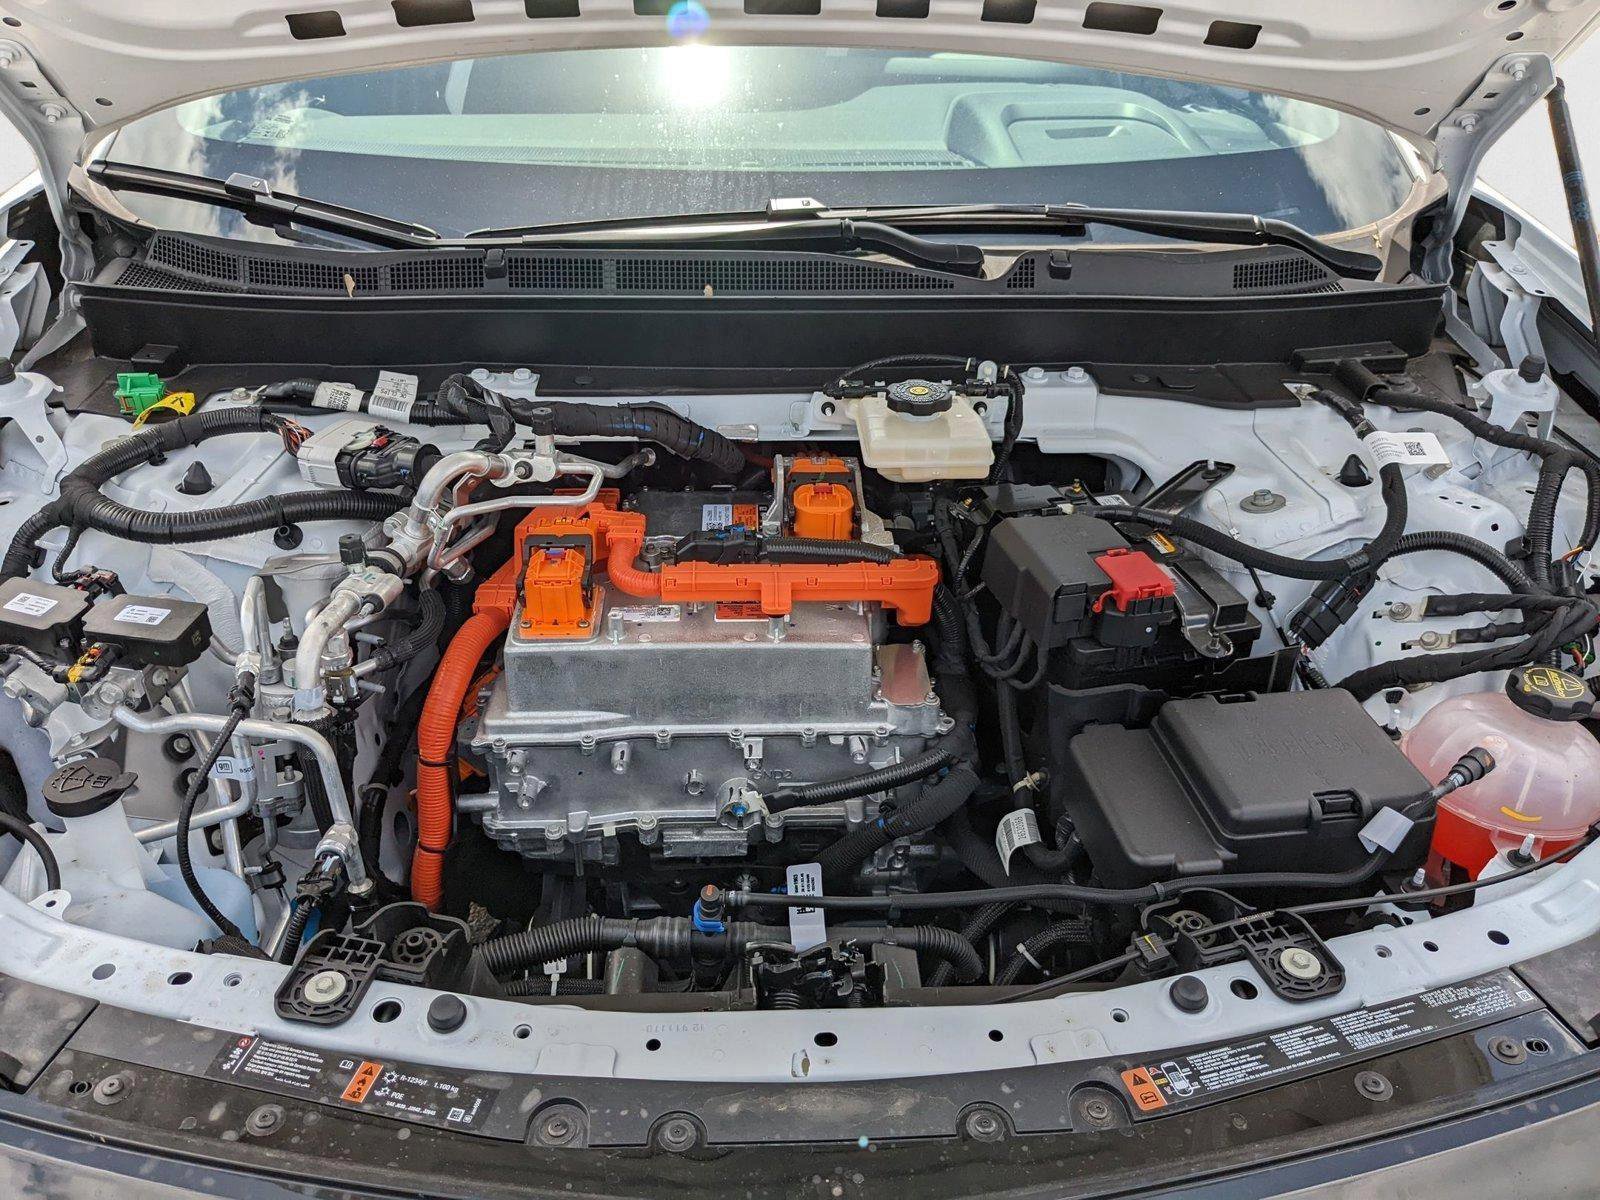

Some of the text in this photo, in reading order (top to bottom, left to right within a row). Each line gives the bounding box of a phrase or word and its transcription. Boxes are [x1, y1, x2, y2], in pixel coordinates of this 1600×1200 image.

[218, 762, 230, 770] gm
[752, 769, 793, 780] GND2
[399, 1074, 459, 1093] R-1234yf 1.100 kg
[391, 1091, 405, 1100] POE
